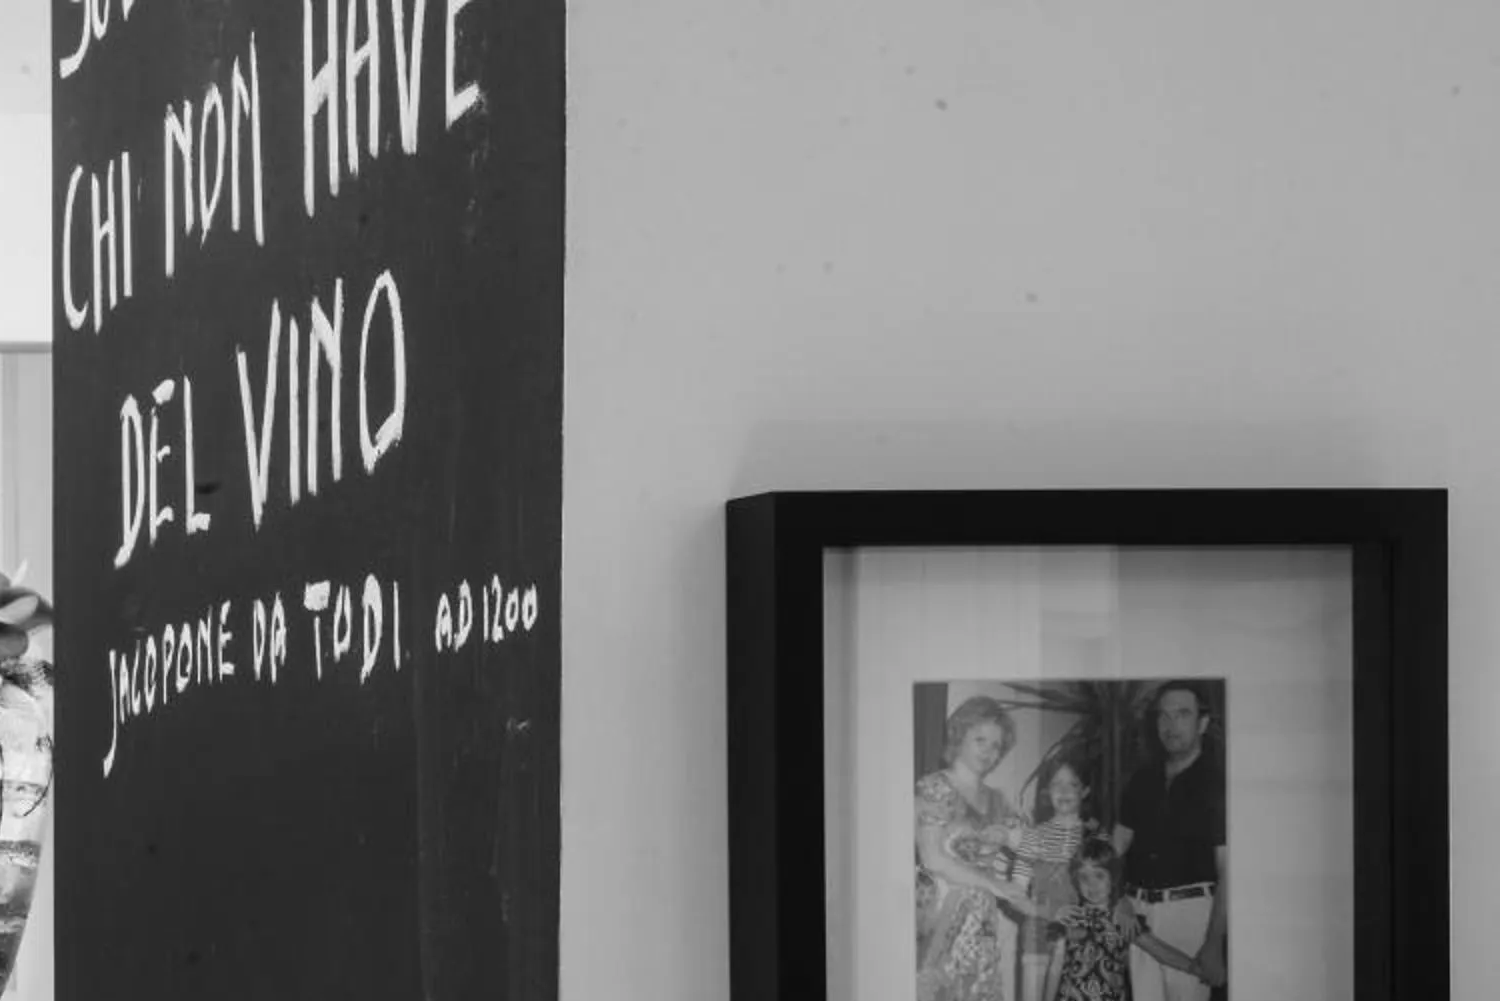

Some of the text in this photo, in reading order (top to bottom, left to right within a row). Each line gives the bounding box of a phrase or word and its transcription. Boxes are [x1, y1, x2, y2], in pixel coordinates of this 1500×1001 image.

[62, 0, 486, 334] CHI NON HAVE
[114, 270, 406, 569] DEL VINO
[103, 600, 236, 779] JACOPONE
[253, 592, 288, 684] DA
[303, 573, 401, 685] TODI
[483, 573, 538, 643] 1200
